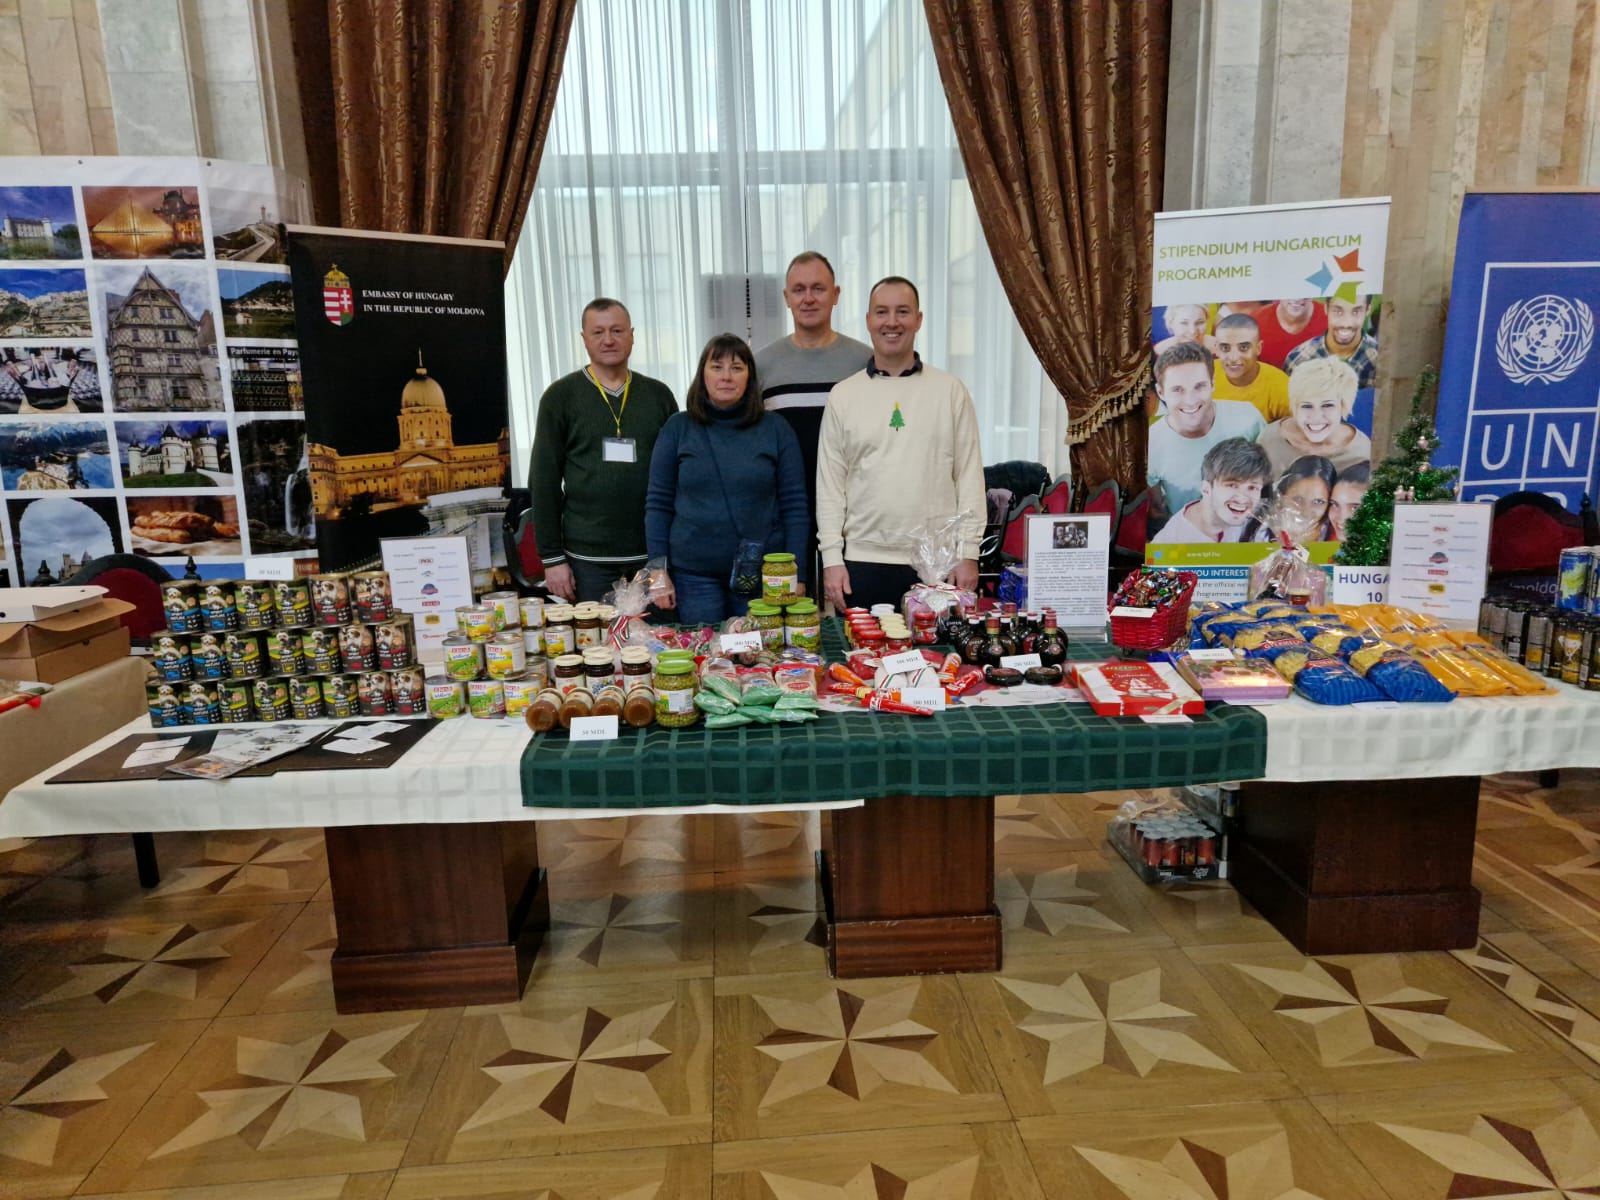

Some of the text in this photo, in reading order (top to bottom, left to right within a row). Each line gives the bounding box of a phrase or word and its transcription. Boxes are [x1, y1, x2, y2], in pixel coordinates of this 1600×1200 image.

[1159, 234, 1362, 259] STIPENDIUM HUNGARICUM
[1158, 265, 1252, 282] PROGRAMME
[362, 289, 454, 301] EMBASSY OF HUNGARY
[363, 304, 485, 315] IN THE REPUBLIC OF MOLDOVA
